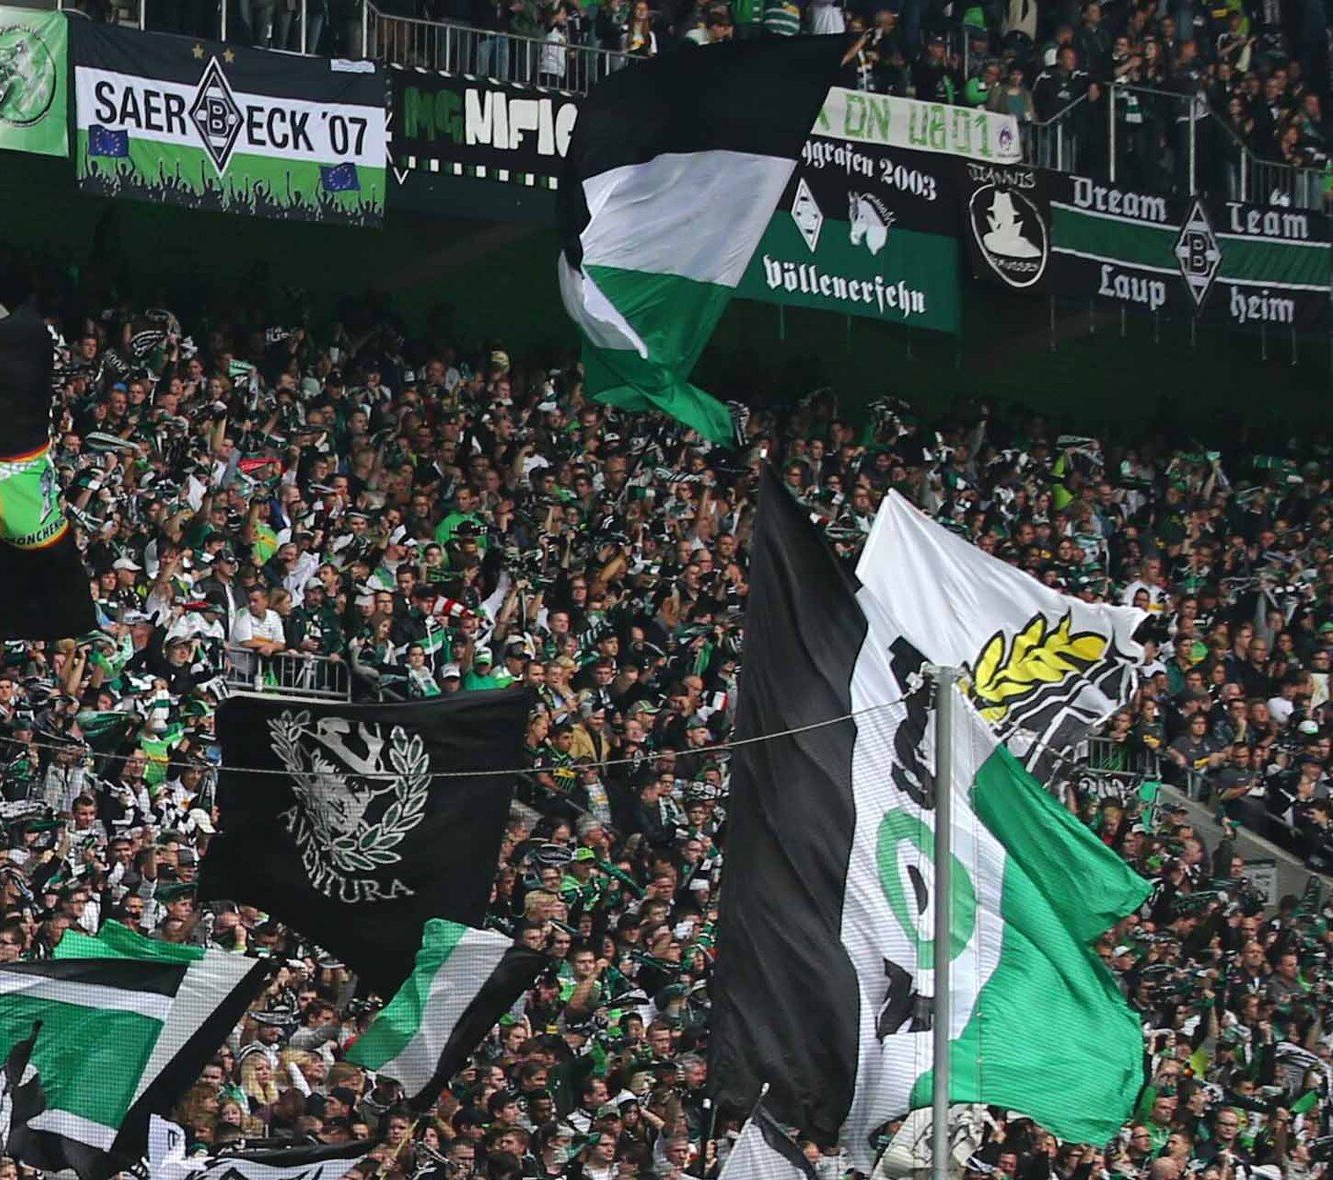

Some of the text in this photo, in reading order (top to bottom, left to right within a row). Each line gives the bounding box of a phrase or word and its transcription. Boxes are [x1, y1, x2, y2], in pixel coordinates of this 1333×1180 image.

[879, 158, 937, 201] 2003
[1070, 175, 1309, 240] Dream Team
[1098, 265, 1295, 323] Laup heim
[277, 806, 416, 903] AVENTURA
